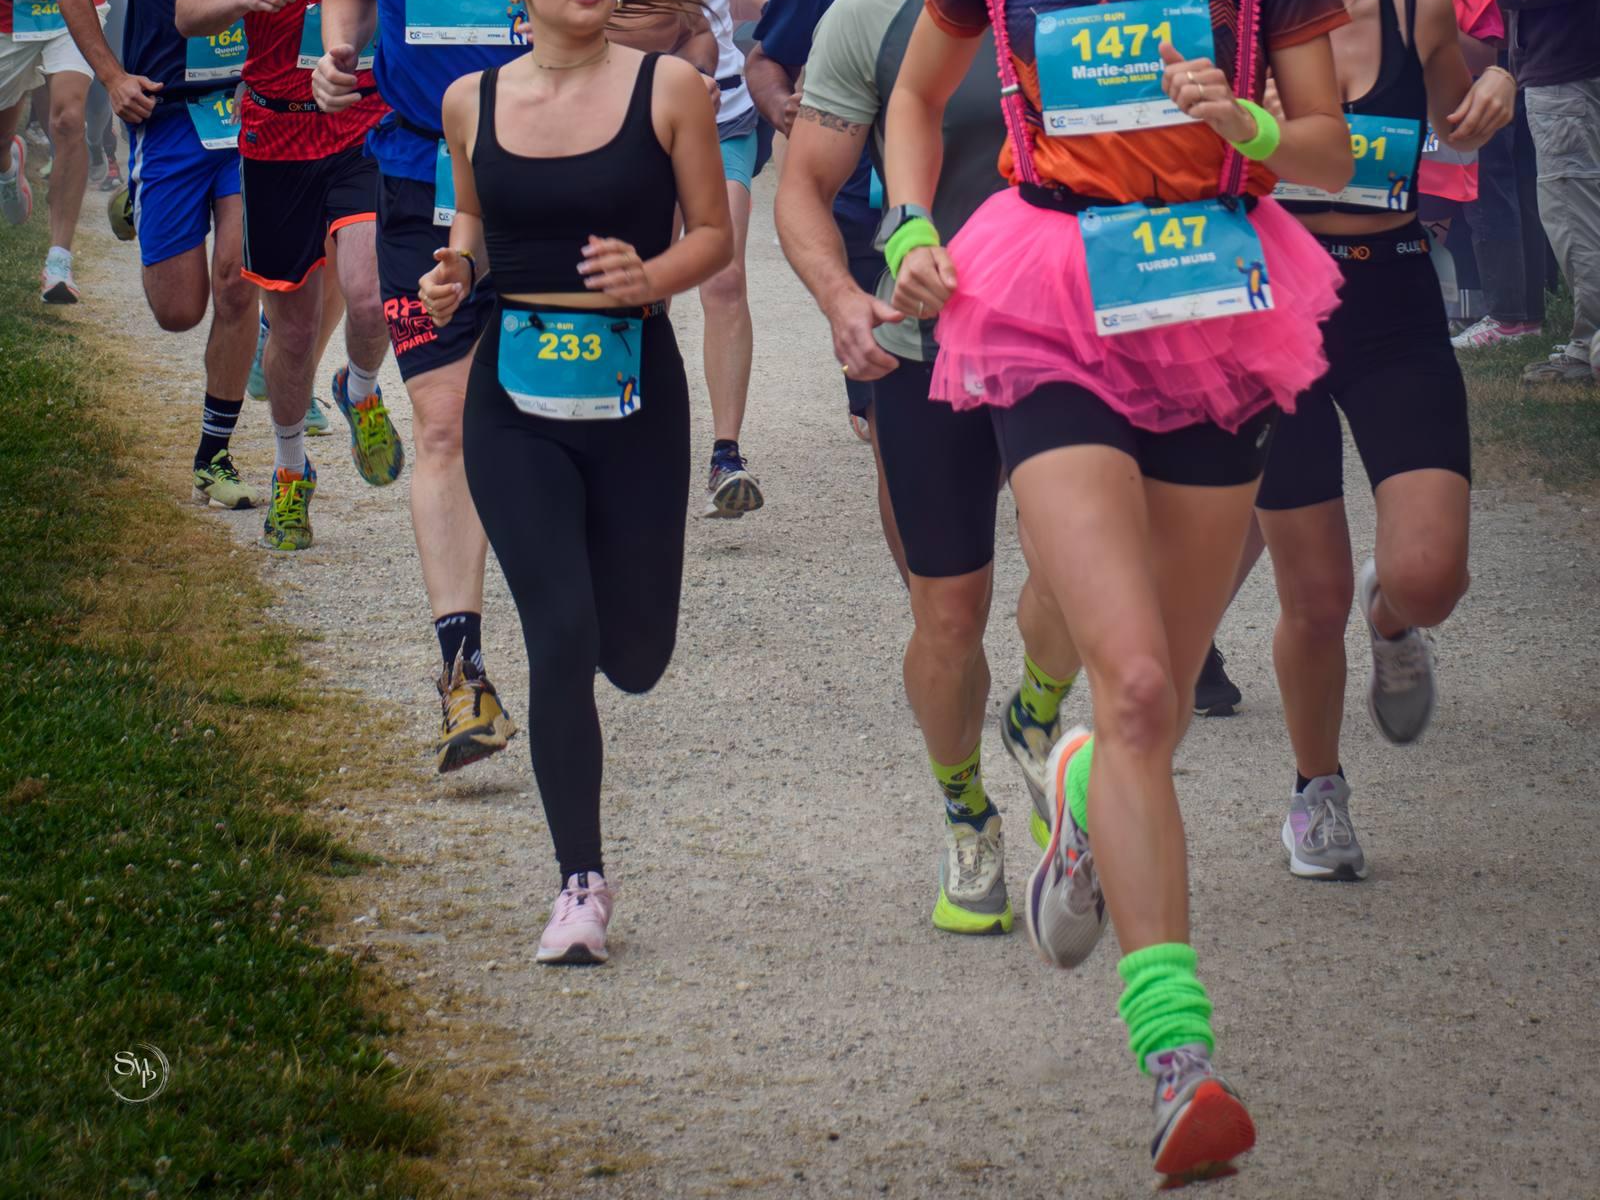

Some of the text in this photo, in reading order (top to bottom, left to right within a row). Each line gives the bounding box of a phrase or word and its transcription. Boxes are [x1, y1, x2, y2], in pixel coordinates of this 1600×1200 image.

[207, 28, 246, 47] 164
[1072, 21, 1173, 61] 1471
[1072, 59, 1165, 80] Marie-amel
[213, 98, 235, 117] 16
[1350, 135, 1387, 161] 91
[1132, 215, 1207, 254] 147
[1137, 252, 1216, 272] TURBO MUMS
[537, 334, 602, 361] 233
